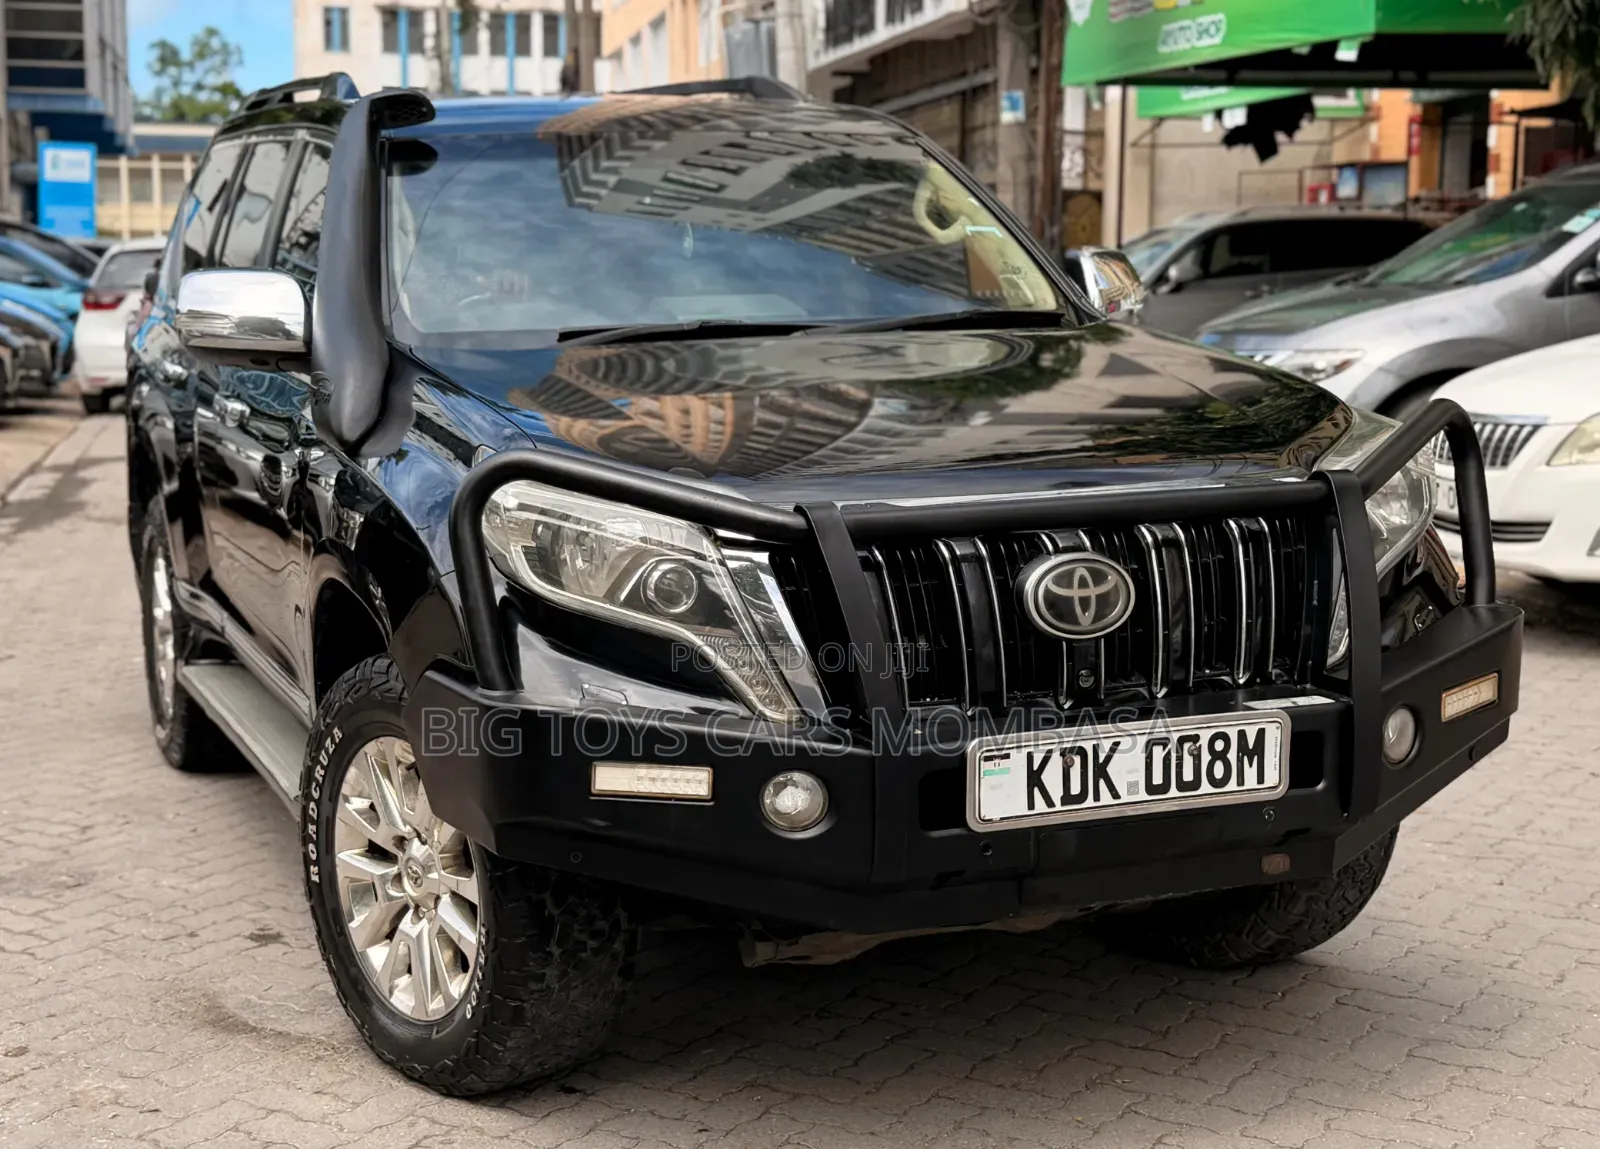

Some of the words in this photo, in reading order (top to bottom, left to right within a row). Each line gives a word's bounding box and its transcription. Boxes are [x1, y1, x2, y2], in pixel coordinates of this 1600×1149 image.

[308, 726, 343, 884] ROADCRUZA
[1026, 740, 1122, 811] KDK
[1144, 727, 1266, 797] 008M
